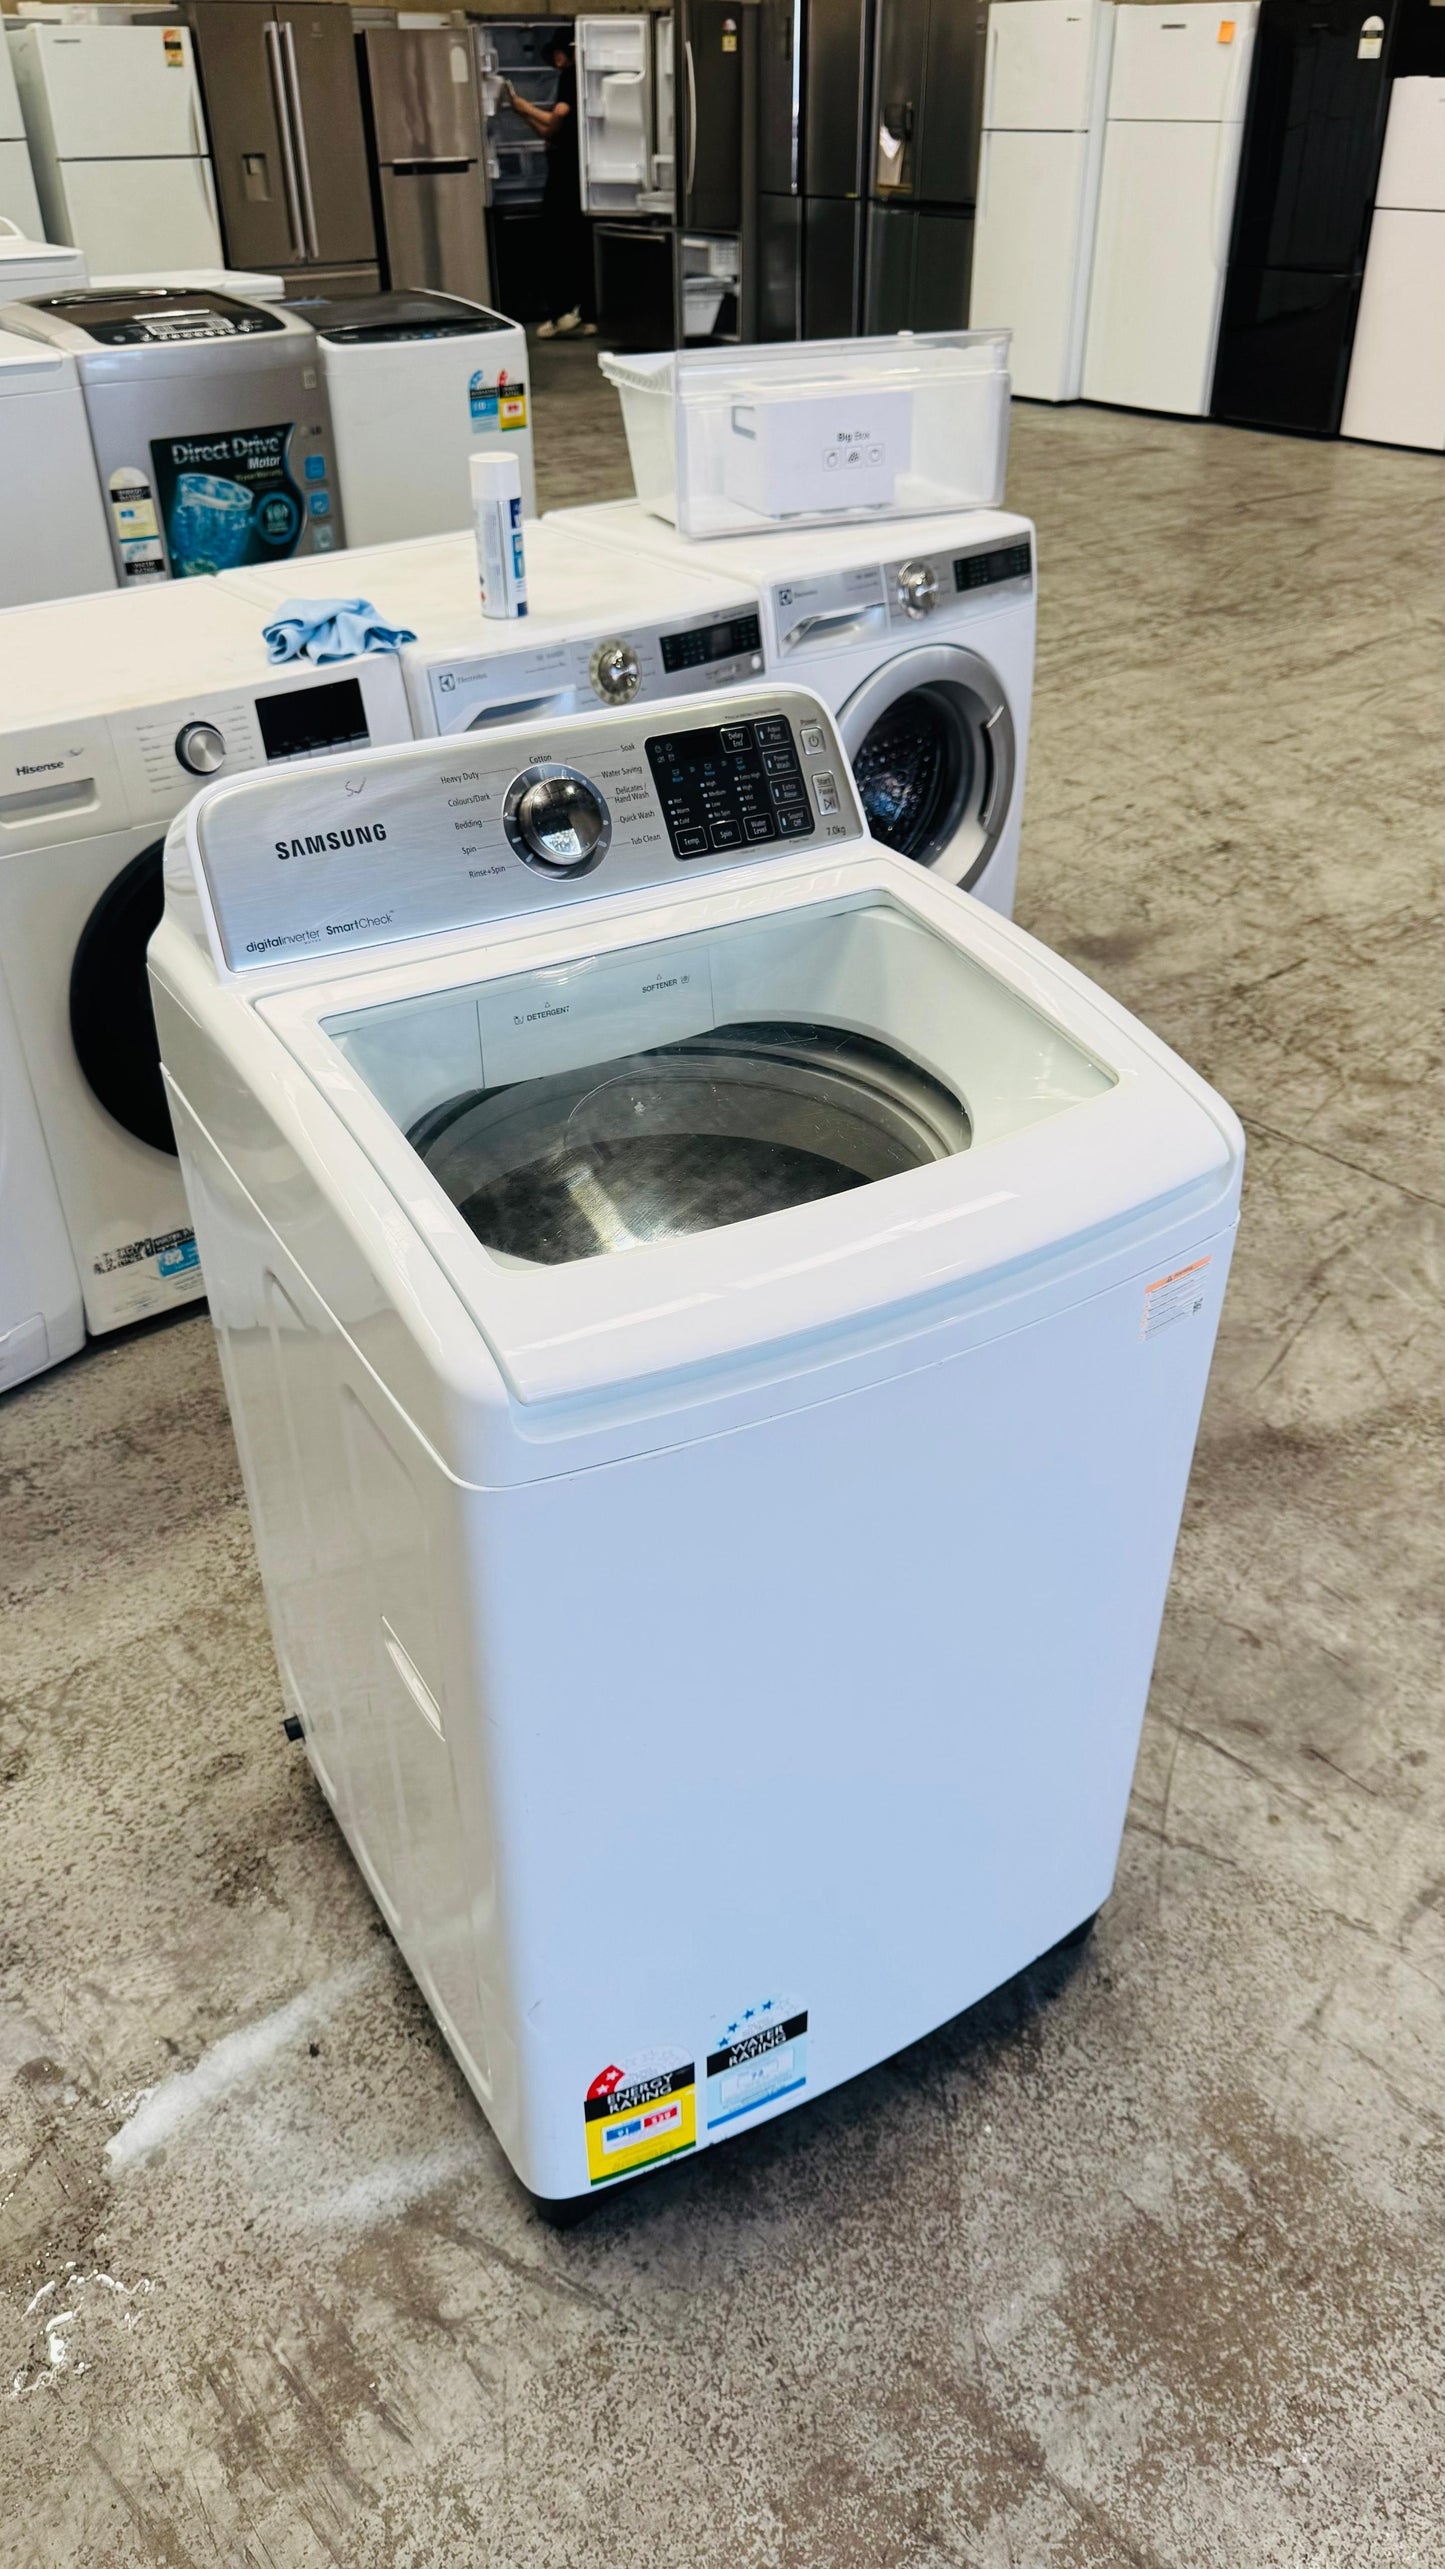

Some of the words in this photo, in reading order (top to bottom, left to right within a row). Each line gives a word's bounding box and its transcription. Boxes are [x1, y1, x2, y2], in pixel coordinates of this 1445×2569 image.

[171, 440, 230, 465] Direct
[232, 434, 280, 457] Drive
[247, 456, 281, 470] Motor
[620, 743, 635, 752] Soak
[529, 754, 552, 764] Cotton
[16, 761, 64, 776] Hisense
[601, 770, 620, 779] Water
[621, 766, 643, 775] Saving
[440, 775, 462, 784] Heavy
[462, 771, 479, 781] Duty
[615, 784, 644, 795] Delicates
[447, 792, 491, 807] Colours/Dark
[614, 794, 632, 803] Hand
[631, 791, 650, 801] Wash
[620, 814, 637, 824] Quick
[637, 809, 656, 819] Wash
[454, 819, 483, 831] Bedding
[275, 823, 387, 860] SAMSUNG
[631, 837, 643, 845] Tub
[643, 833, 662, 843] Clean
[461, 845, 477, 855] Spin
[468, 865, 506, 878] Rinse+Spin
[642, 978, 678, 993] SOFTENER
[526, 1005, 571, 1022] DETERGENT
[731, 2023, 784, 2055] WATER
[728, 2034, 786, 2067] RATING
[607, 2073, 674, 2105] ENERGY
[609, 2082, 673, 2115] RATING
